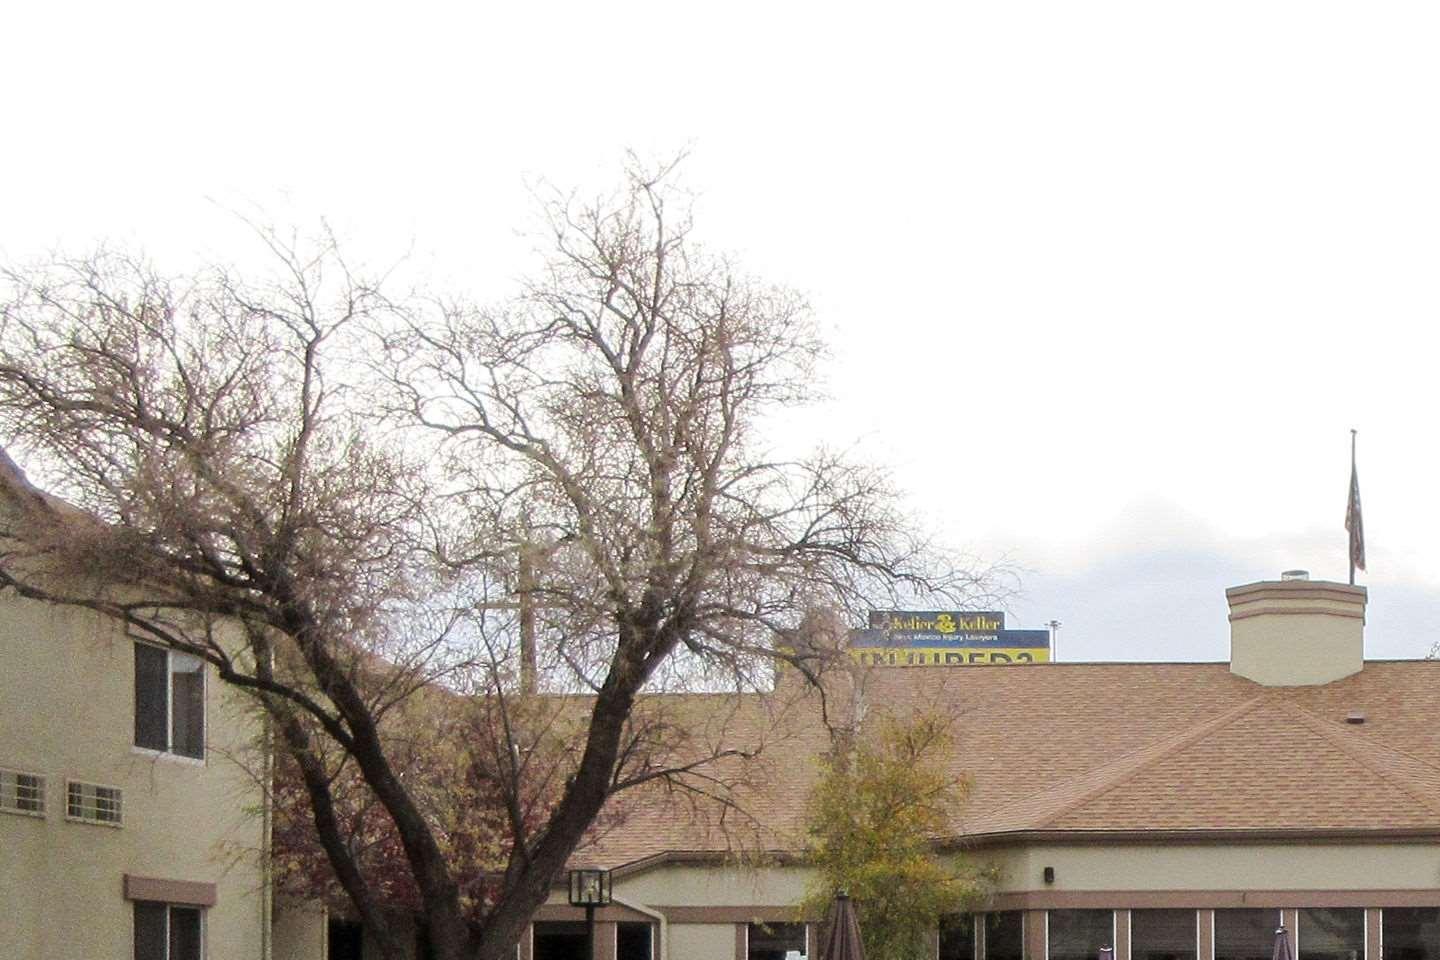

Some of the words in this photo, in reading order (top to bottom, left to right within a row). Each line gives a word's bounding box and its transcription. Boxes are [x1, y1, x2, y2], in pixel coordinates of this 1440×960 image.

[935, 614, 956, 634] &
[959, 616, 1000, 630] Keller
[913, 633, 941, 641] Mexico
[942, 633, 963, 642] Injury
[965, 633, 999, 642] Lawyers
